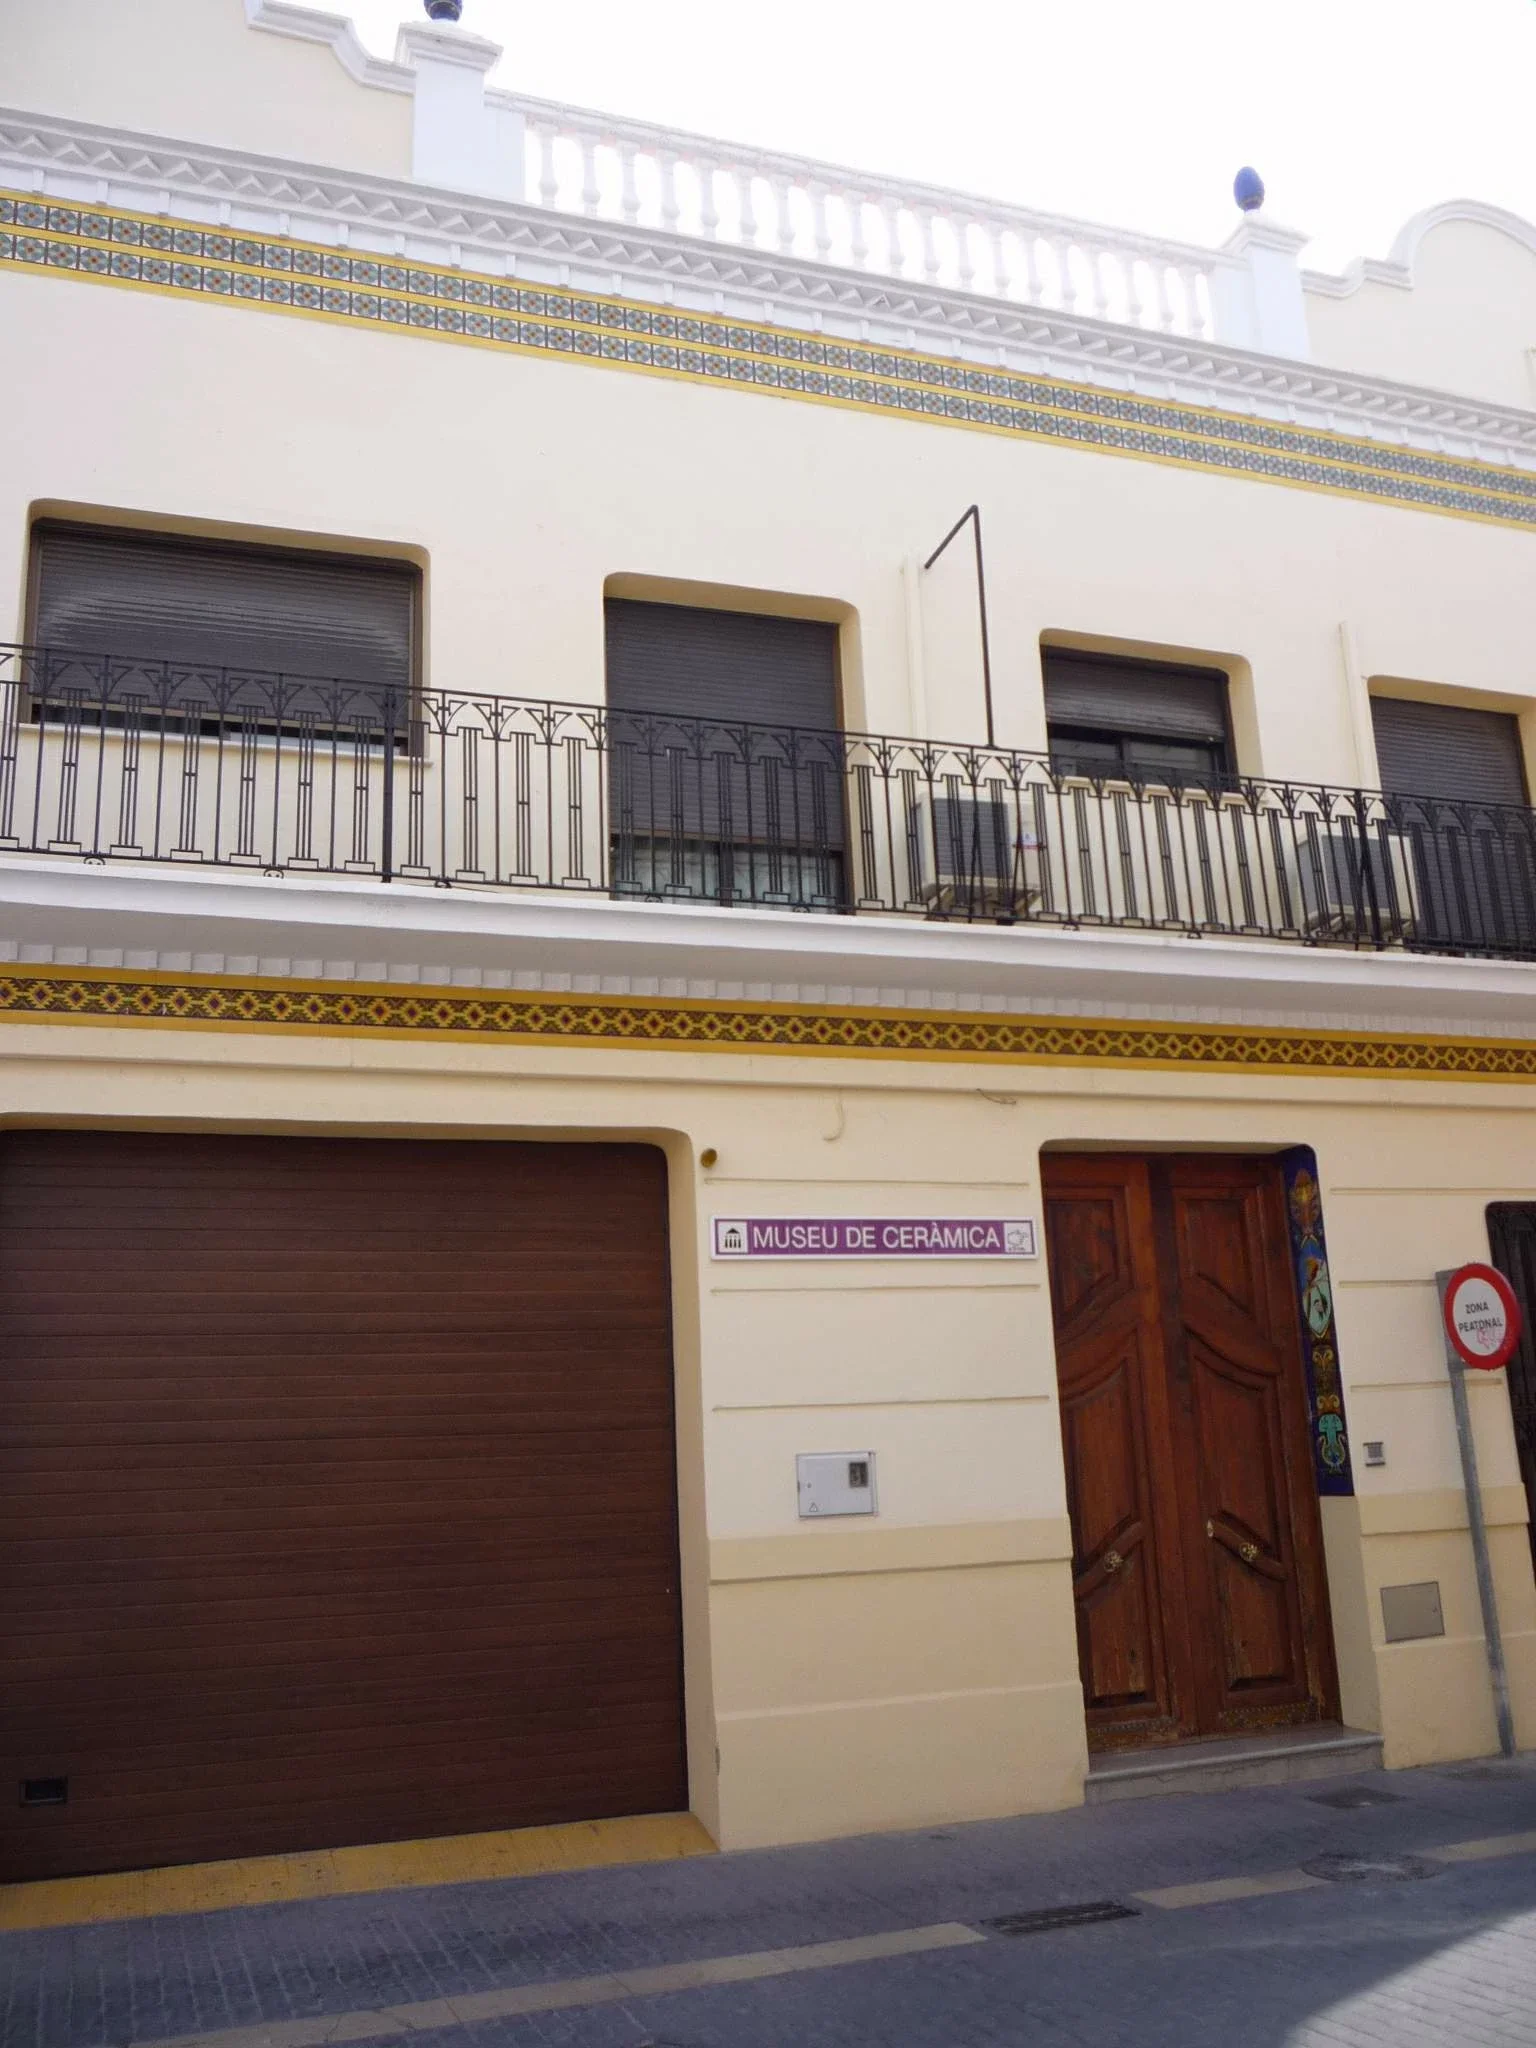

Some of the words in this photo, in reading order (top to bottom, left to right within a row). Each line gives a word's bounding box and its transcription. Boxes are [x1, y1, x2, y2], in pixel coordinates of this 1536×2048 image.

[752, 1225, 838, 1249] MUSEU
[846, 1226, 876, 1249] DE
[882, 1222, 1000, 1249] CERÀMICA
[1465, 1302, 1489, 1314] ZONA
[1459, 1318, 1503, 1332] PEATONAL
